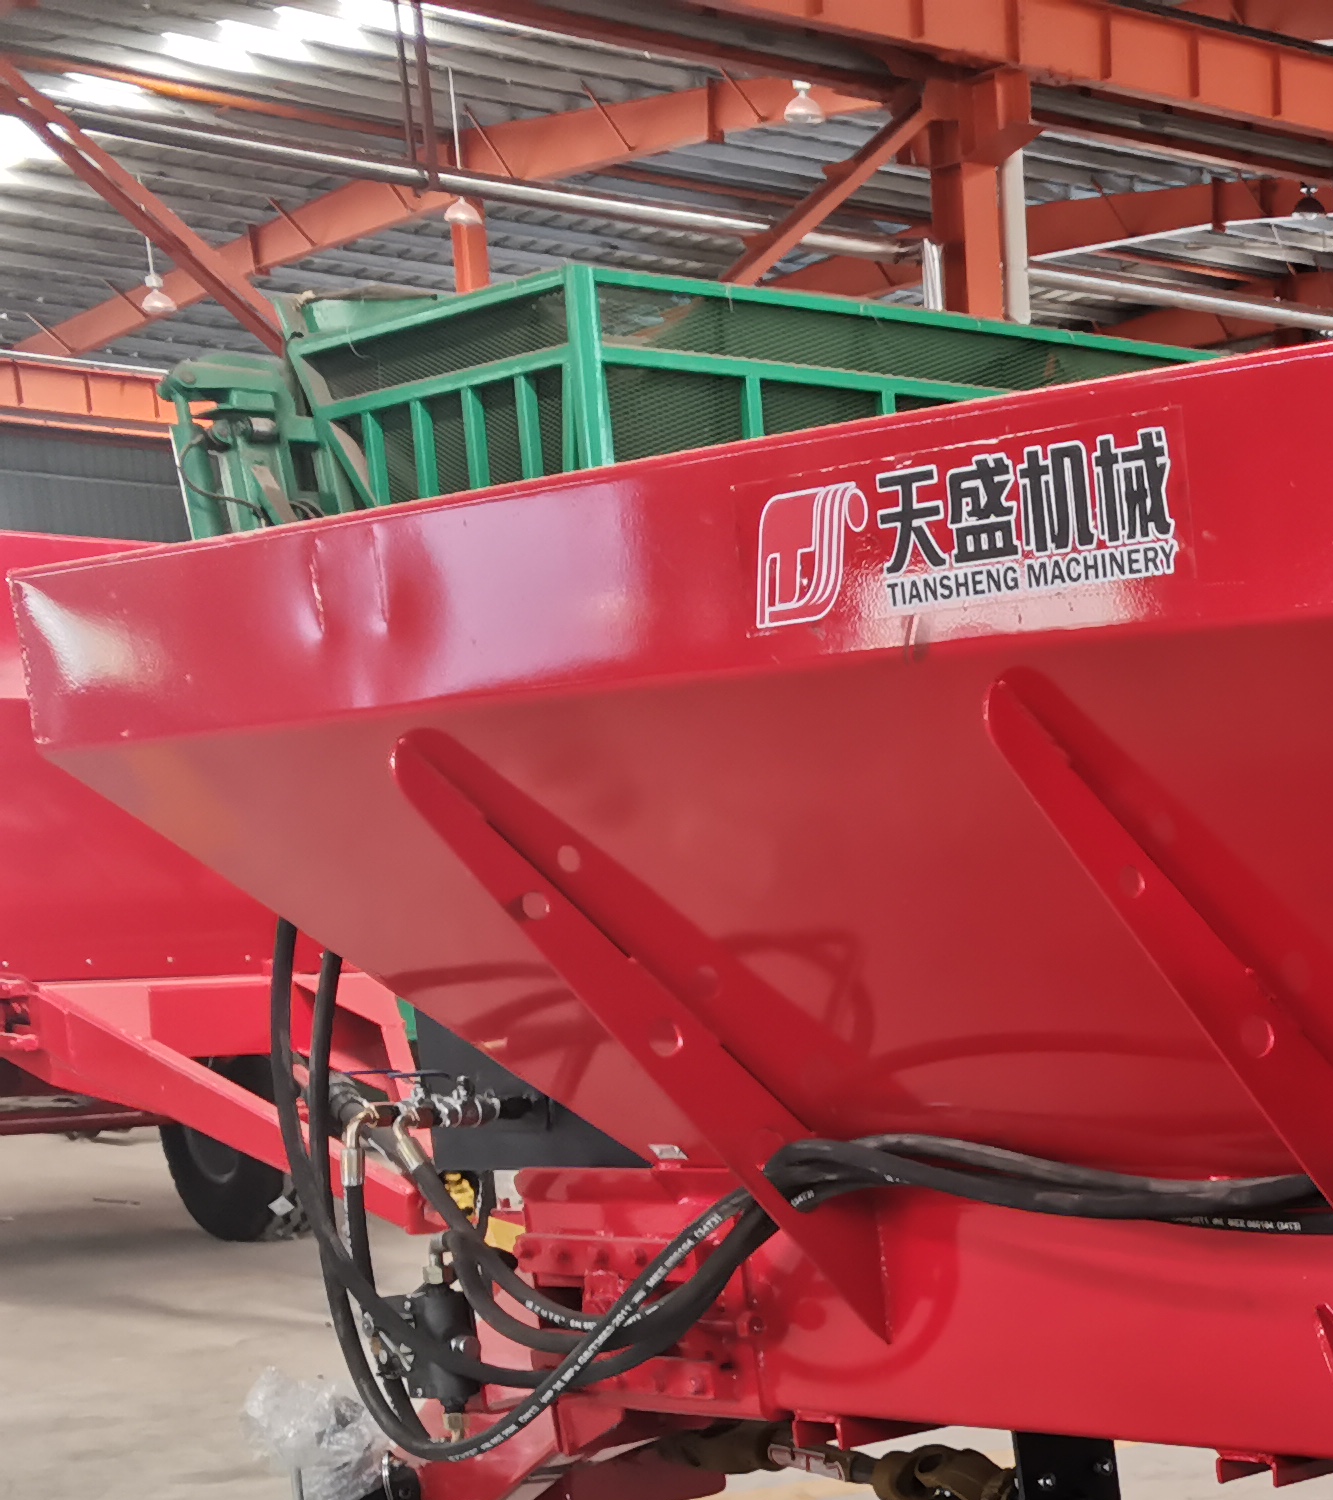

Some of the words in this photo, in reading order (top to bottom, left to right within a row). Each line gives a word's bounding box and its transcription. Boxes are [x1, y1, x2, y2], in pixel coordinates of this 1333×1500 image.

[875, 426, 1177, 574] 天盛机械
[886, 567, 1020, 609] TIANSHENG
[1026, 544, 1177, 590] MACHINERY
